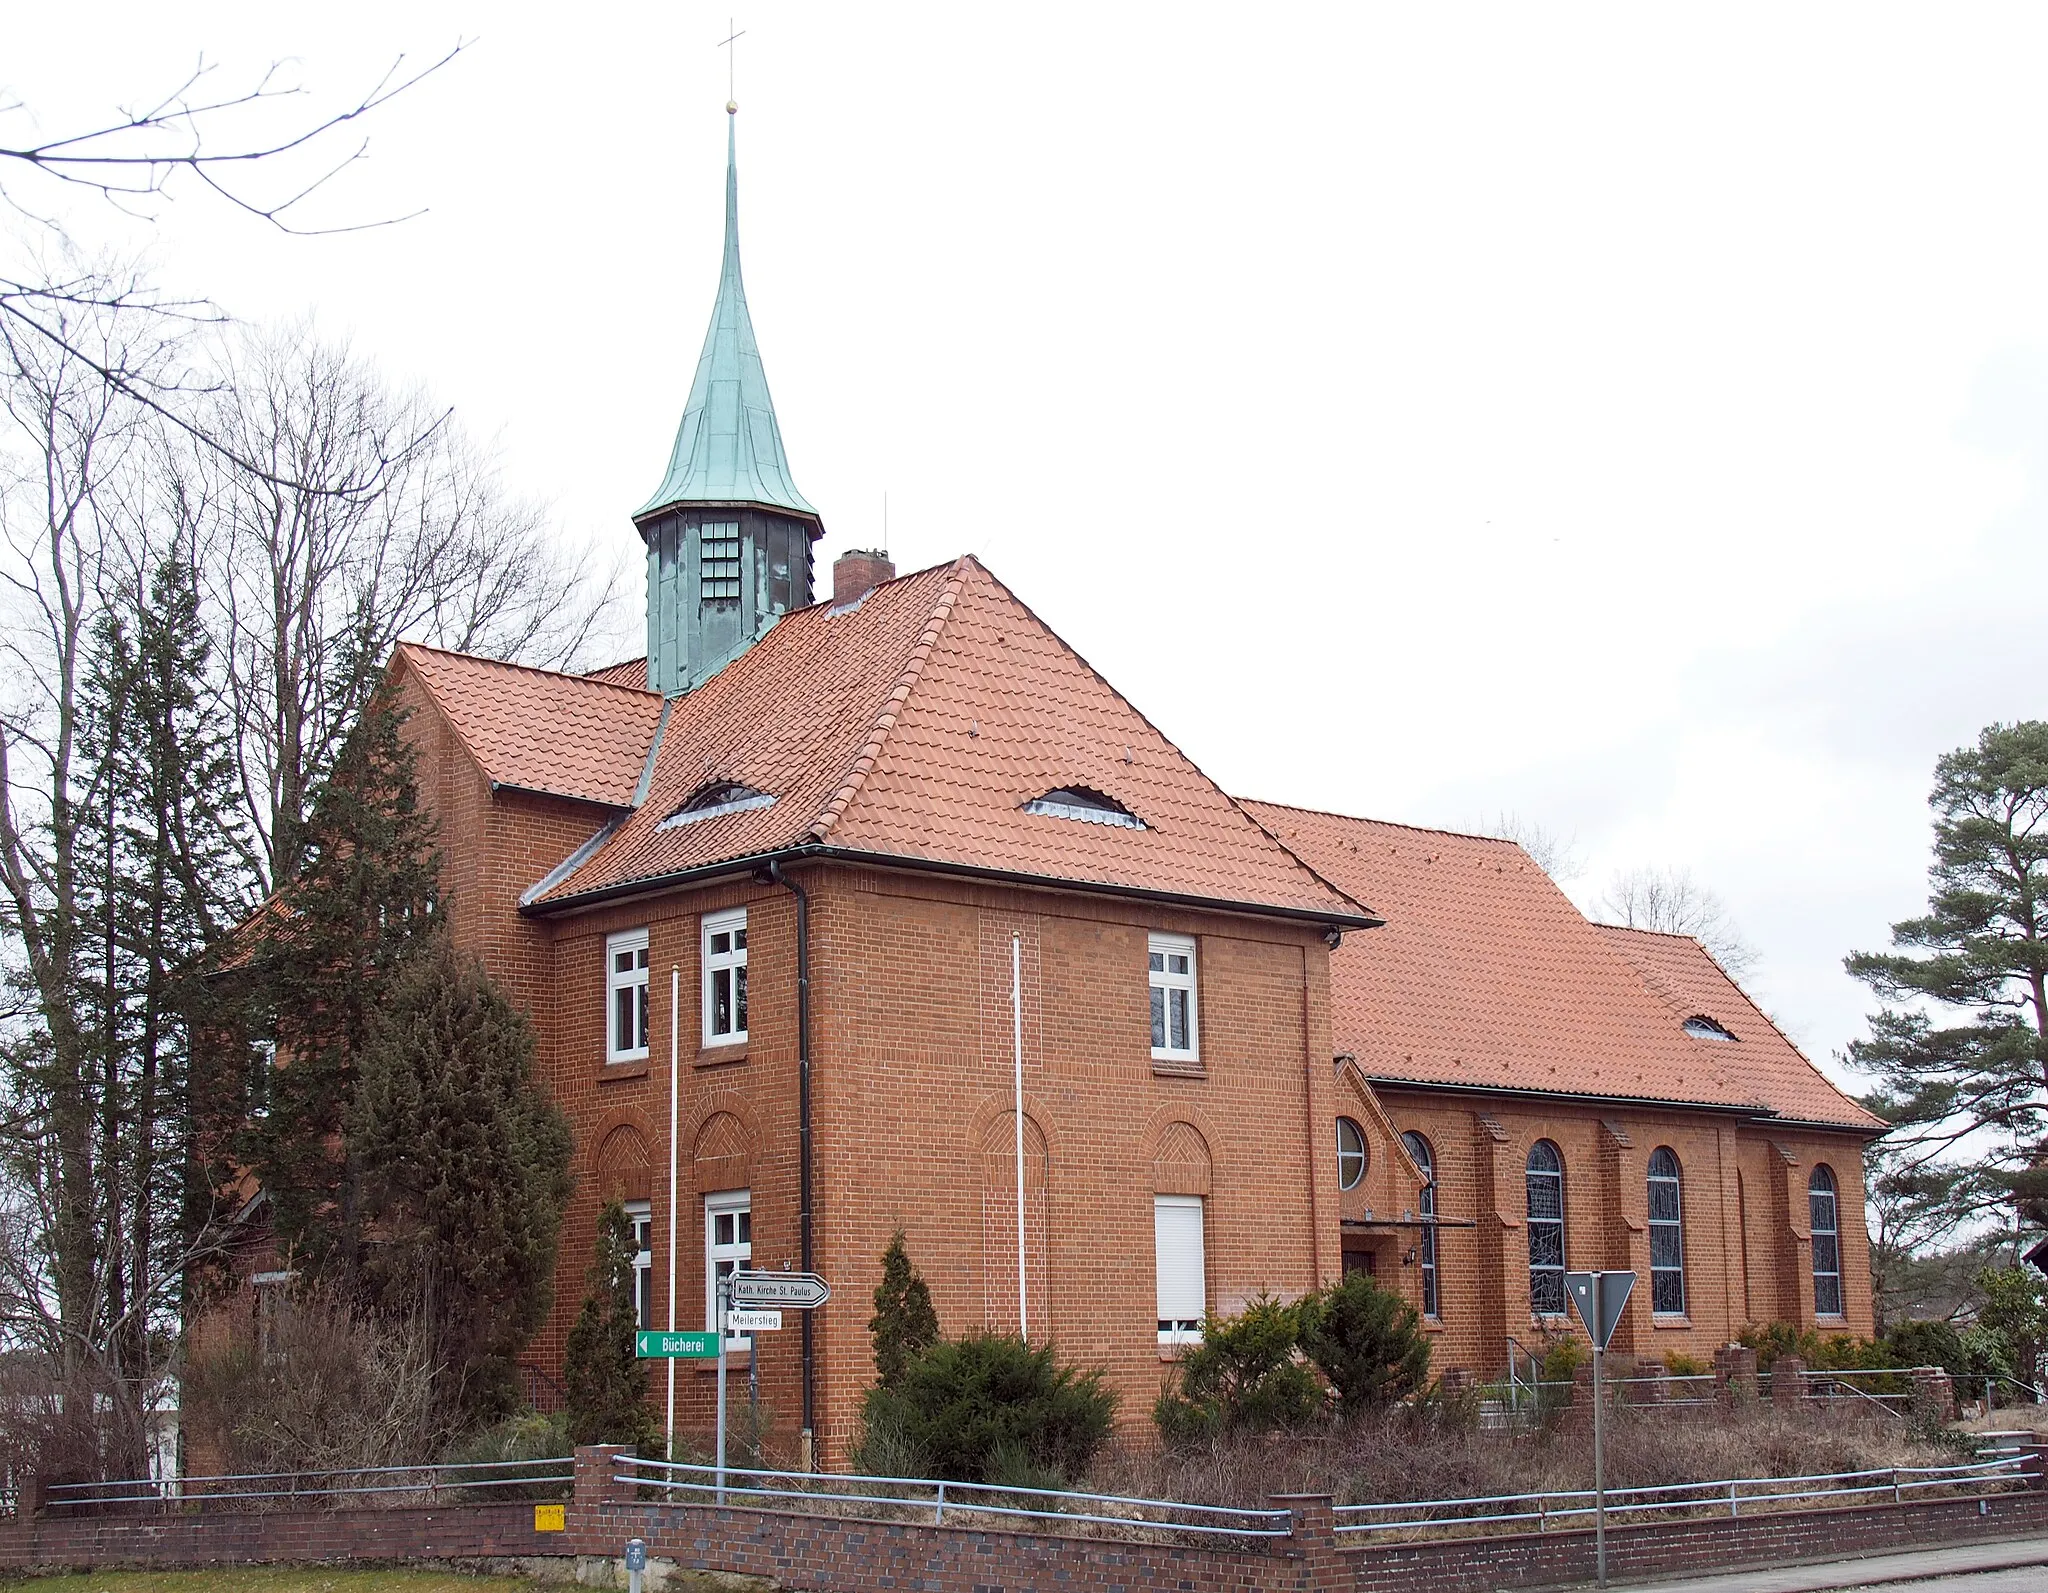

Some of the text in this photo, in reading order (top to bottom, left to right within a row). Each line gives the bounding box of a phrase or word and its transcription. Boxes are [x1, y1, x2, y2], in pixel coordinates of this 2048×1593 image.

[738, 1284, 811, 1296] Kath. Kirche St. Paulus
[732, 1314, 778, 1328] Meilerstieg
[662, 1337, 704, 1352] Bücherei
